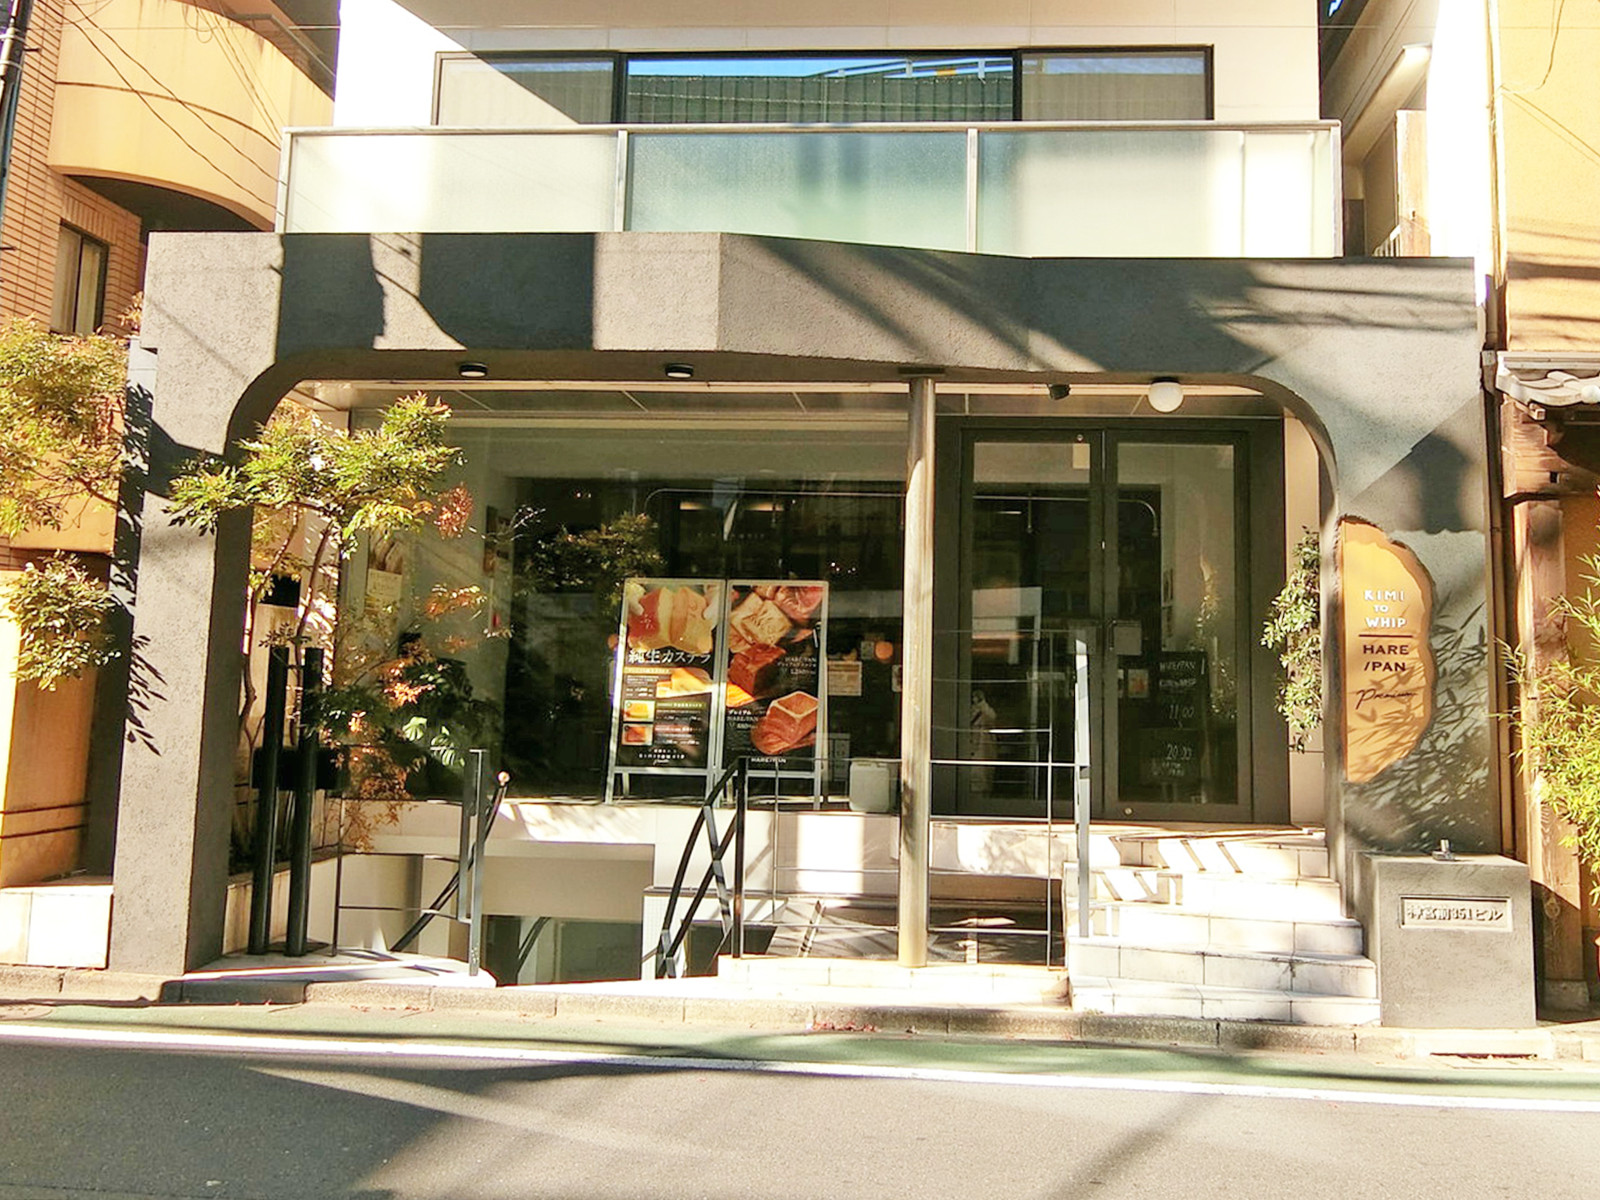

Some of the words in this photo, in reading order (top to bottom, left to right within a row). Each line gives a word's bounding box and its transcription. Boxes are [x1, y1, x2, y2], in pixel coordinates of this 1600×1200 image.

[1364, 589, 1405, 601] KIMI
[1373, 604, 1389, 613] TO
[1364, 616, 1408, 629] WHIP
[1362, 644, 1410, 656] HARE
[1363, 661, 1407, 673] /PAN
